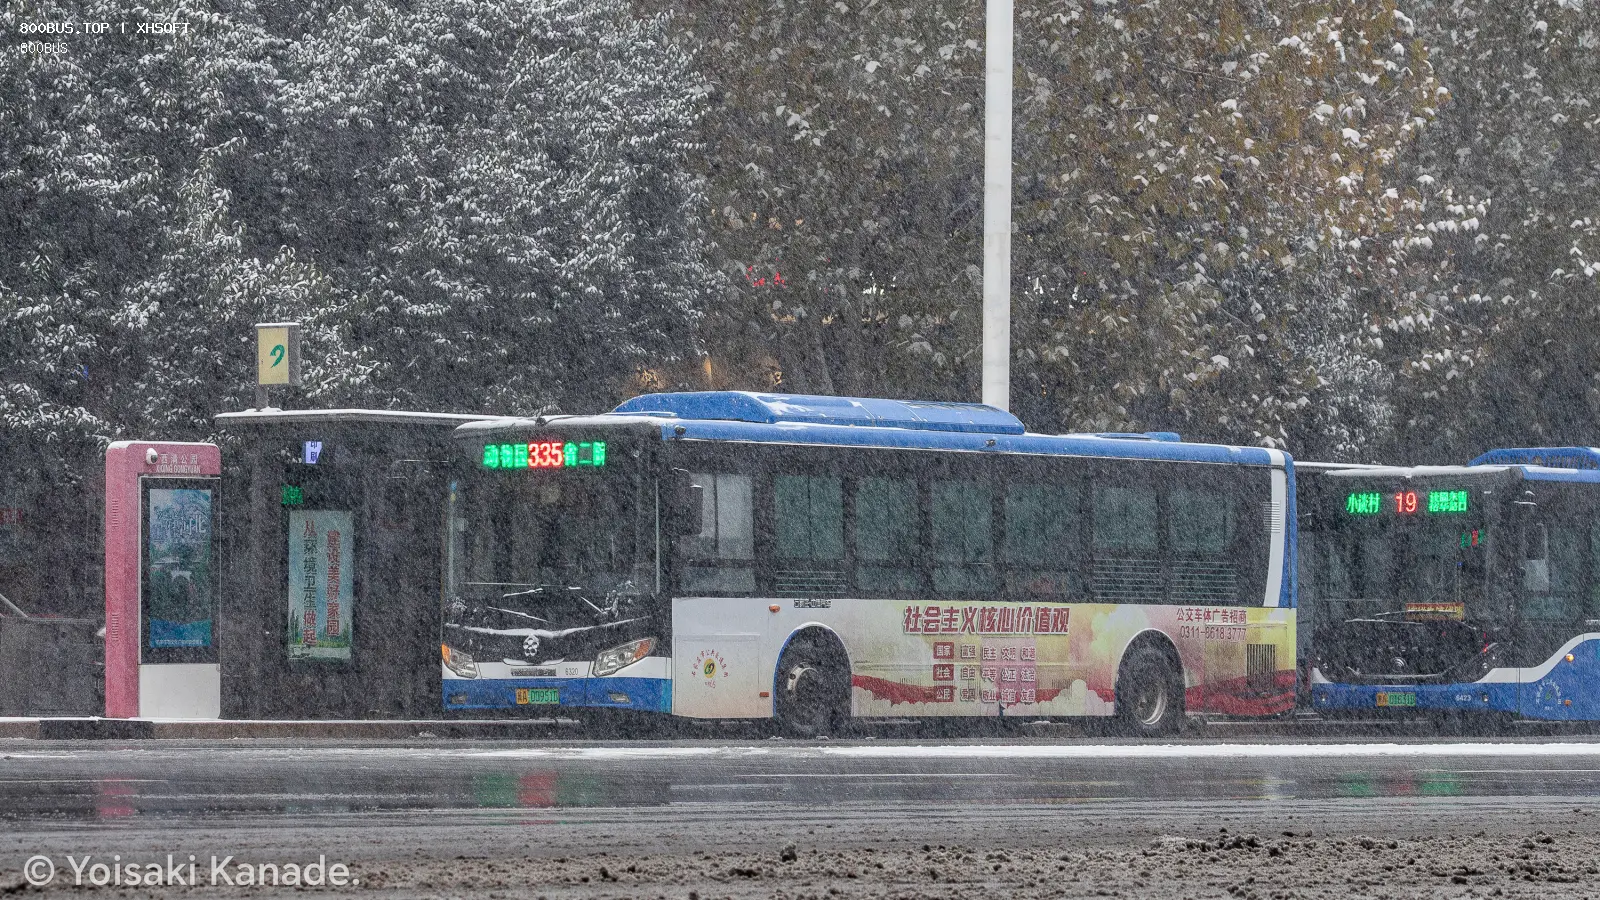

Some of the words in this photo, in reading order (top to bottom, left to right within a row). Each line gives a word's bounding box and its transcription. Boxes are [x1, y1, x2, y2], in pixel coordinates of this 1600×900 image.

[482, 444, 528, 468] 动物园
[527, 443, 562, 467] 335
[1346, 492, 1380, 513] 小谈村
[1395, 492, 1417, 512] 19
[904, 605, 1070, 634] 社会主义核心价值观
[1176, 607, 1247, 624] 公交车体广告招商
[936, 644, 951, 657] 国家
[961, 645, 976, 658] 富强
[982, 647, 997, 659] 民主
[1002, 647, 1017, 659] 文明
[936, 667, 951, 679] 社会
[961, 667, 976, 680] 自由
[982, 667, 997, 681] 平等
[1002, 667, 1017, 681] 公正
[936, 688, 951, 700] 公民
